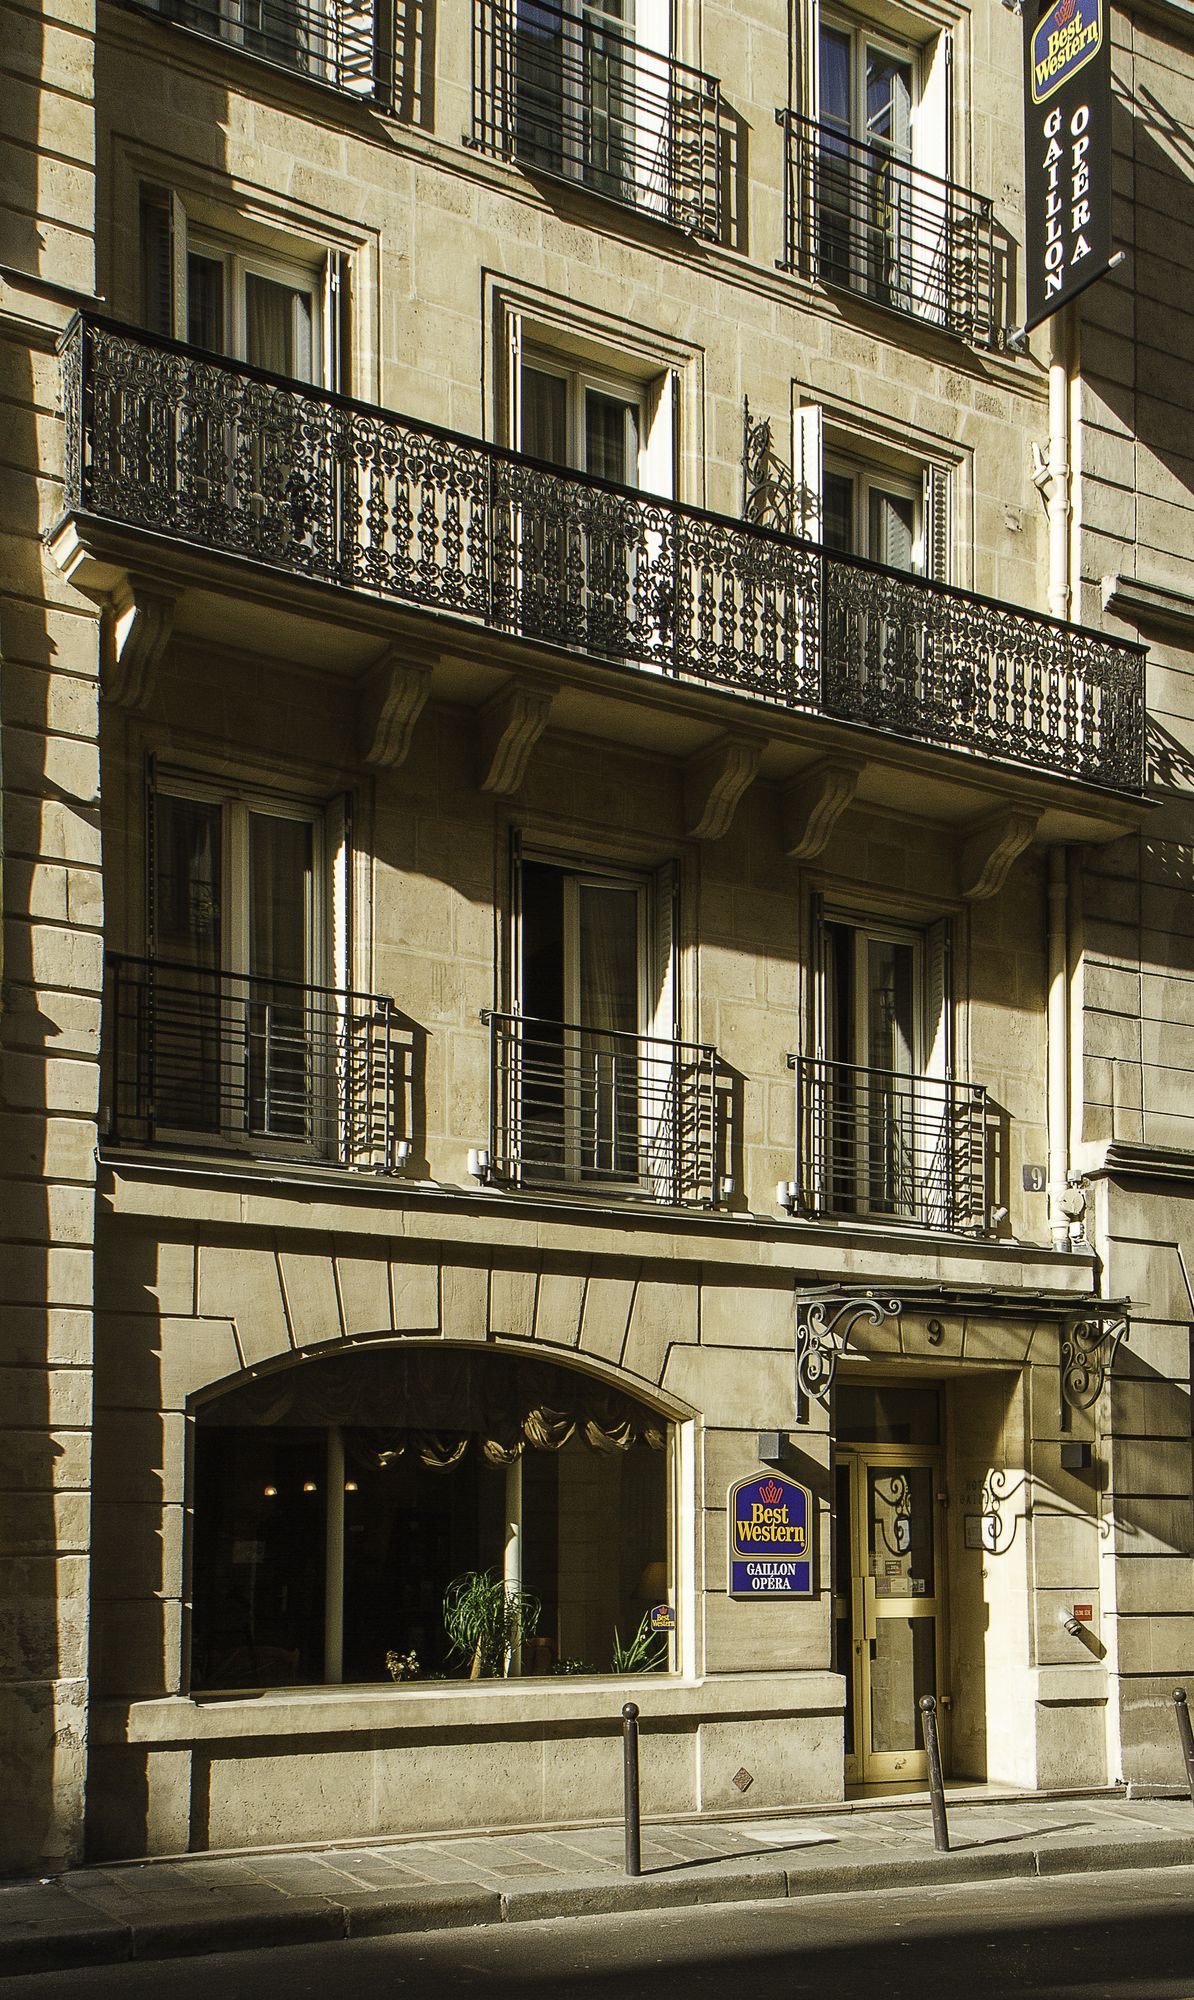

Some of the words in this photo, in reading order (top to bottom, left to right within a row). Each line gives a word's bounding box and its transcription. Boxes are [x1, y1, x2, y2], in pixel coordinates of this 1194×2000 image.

[1047, 9, 1083, 57] Best
[1035, 20, 1099, 87] Western
[1070, 104, 1092, 267] OPÉRA
[1043, 107, 1065, 301] GAILLON
[1031, 1167, 1043, 1191] 9
[927, 1319, 942, 1347] 9
[751, 1503, 789, 1525] Best
[736, 1520, 805, 1542] Western
[746, 1562, 797, 1576] GAILLON
[751, 1575, 792, 1590] OPÉRA
